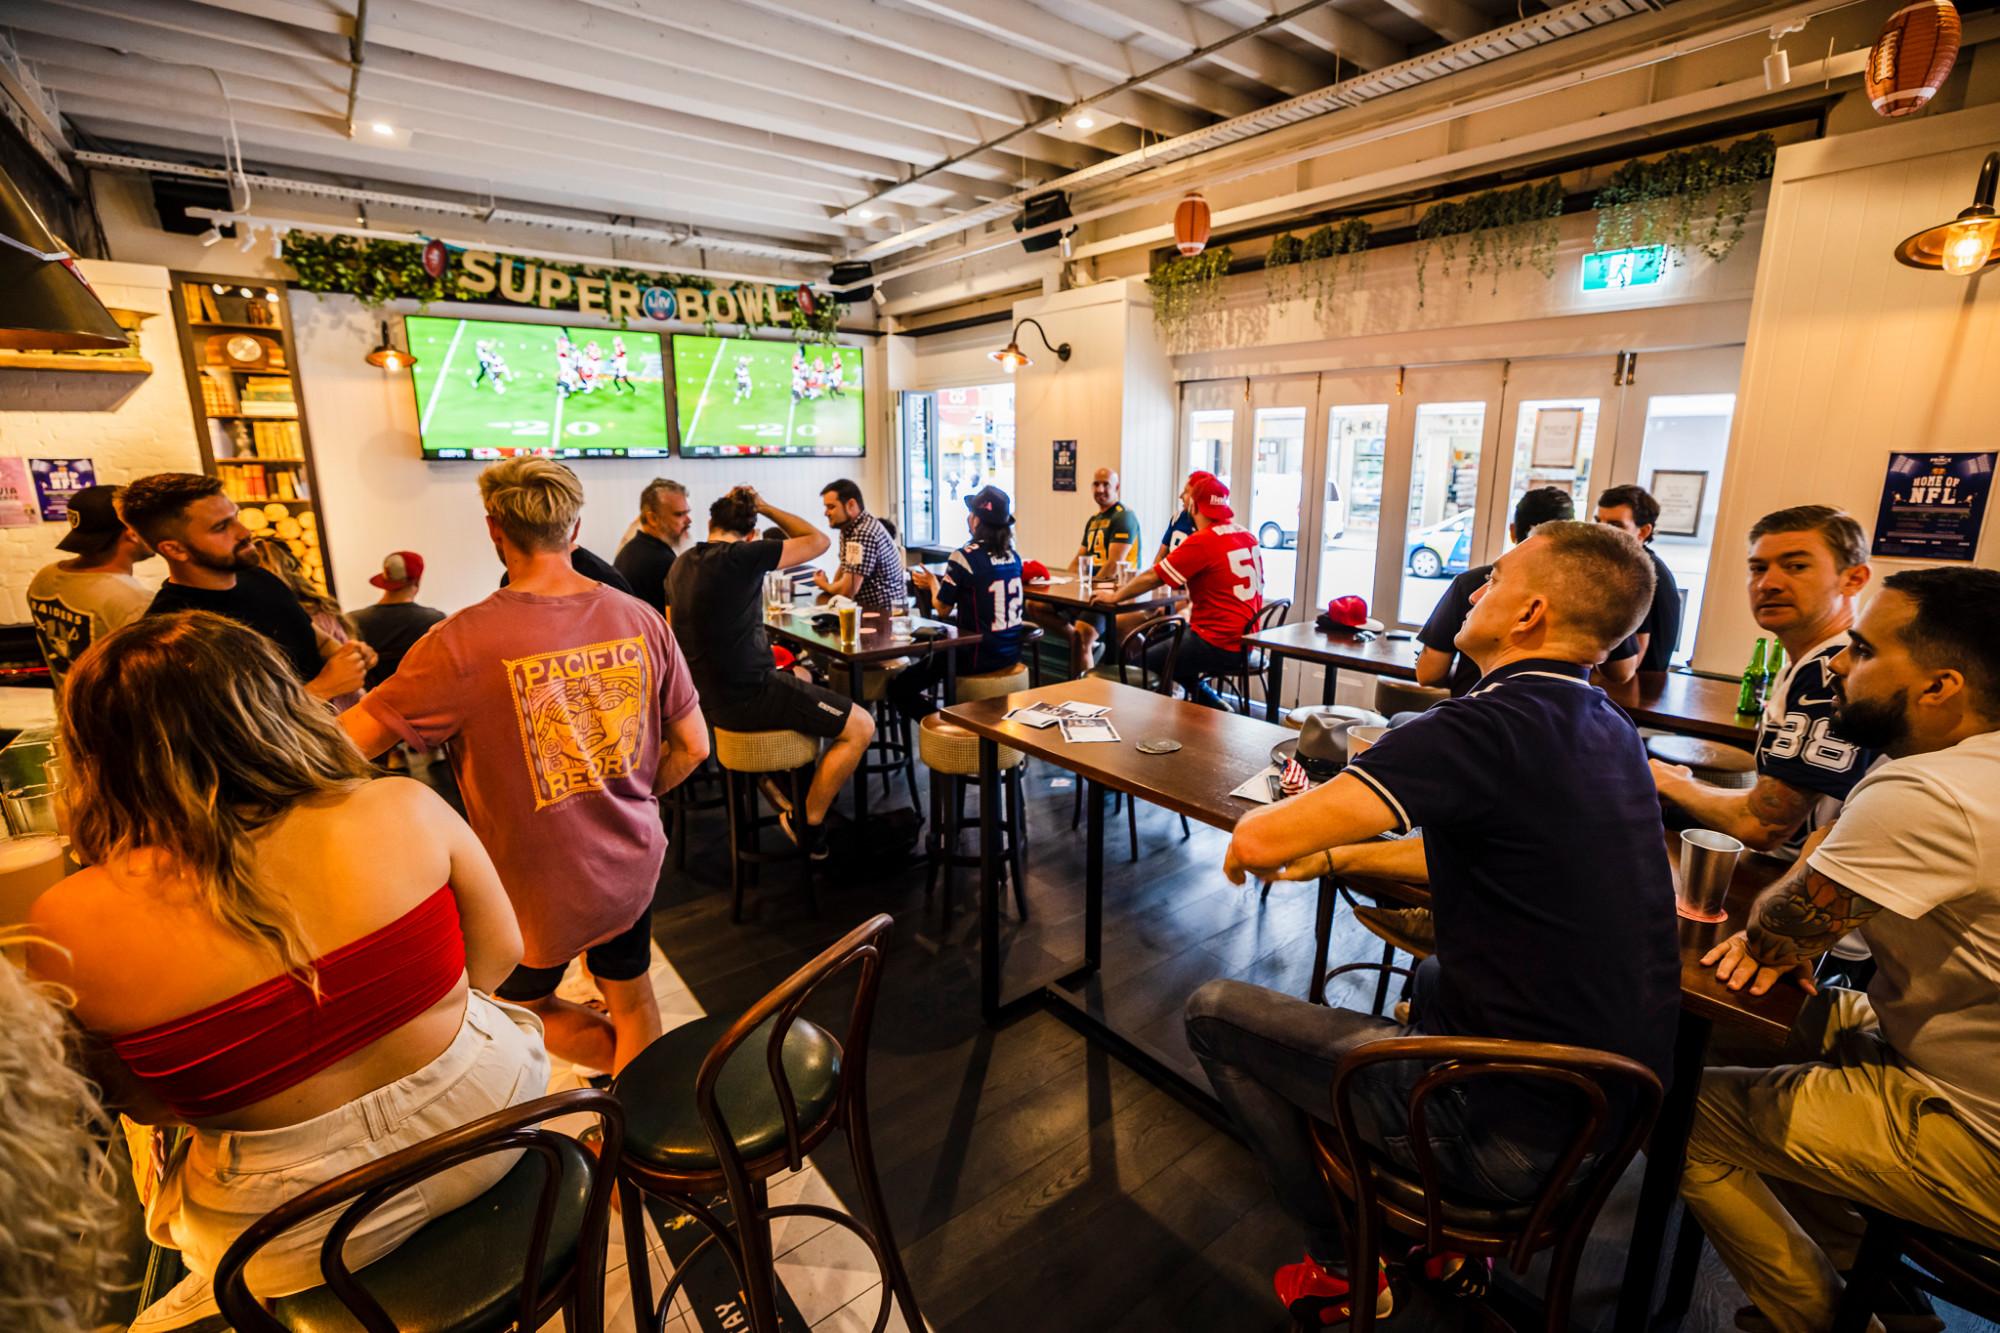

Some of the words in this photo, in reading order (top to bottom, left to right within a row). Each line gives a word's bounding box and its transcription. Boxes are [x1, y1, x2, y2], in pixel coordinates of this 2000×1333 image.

[458, 249, 642, 321] SUPER
[677, 285, 792, 324] BOWL
[1909, 487, 1956, 504] NFL
[1912, 475, 1943, 487] HOME
[1945, 476, 1960, 487] OF
[31, 600, 82, 625] RAIDERS
[988, 577, 1024, 633] 12
[522, 644, 641, 687] PACIFIC
